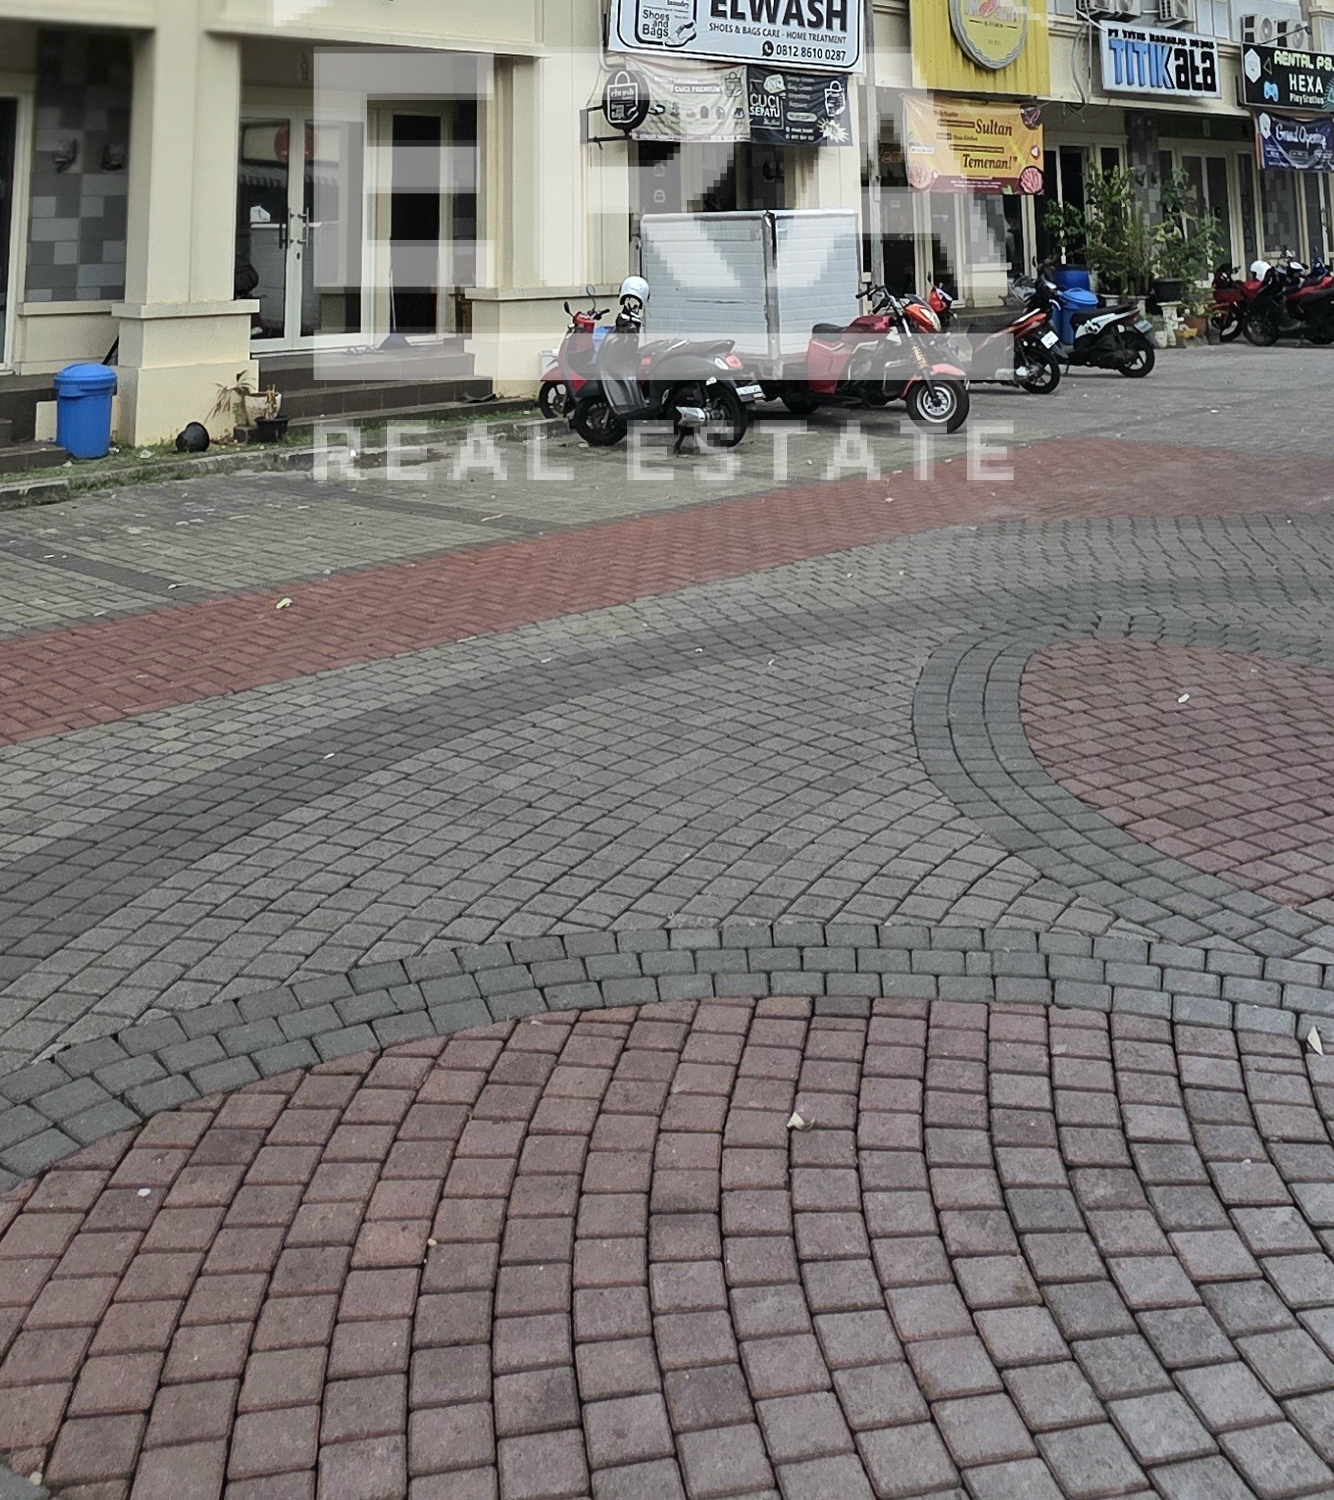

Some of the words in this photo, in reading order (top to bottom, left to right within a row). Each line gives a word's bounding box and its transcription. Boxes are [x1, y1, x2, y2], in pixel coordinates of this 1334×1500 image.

[642, 9, 670, 21] Shoes
[652, 18, 669, 28] and
[642, 23, 669, 39] Bags
[709, 22, 733, 34] SHOES
[735, 25, 741, 34] &
[742, 25, 761, 36] BAGS
[762, 28, 780, 38] CARE
[786, 30, 807, 42] HOME
[808, 33, 847, 45] TREATMENT
[776, 44, 798, 57] 0812
[801, 46, 823, 59] 8610
[825, 48, 847, 62] 0287
[1274, 50, 1314, 69] RENTAL
[1289, 73, 1324, 94] HEXA
[749, 93, 780, 108] CUCI
[749, 105, 781, 117] SEPATU
[975, 118, 1013, 137] Sultan
[1276, 123, 1299, 142] Grand
[1299, 125, 1327, 150] Opening
